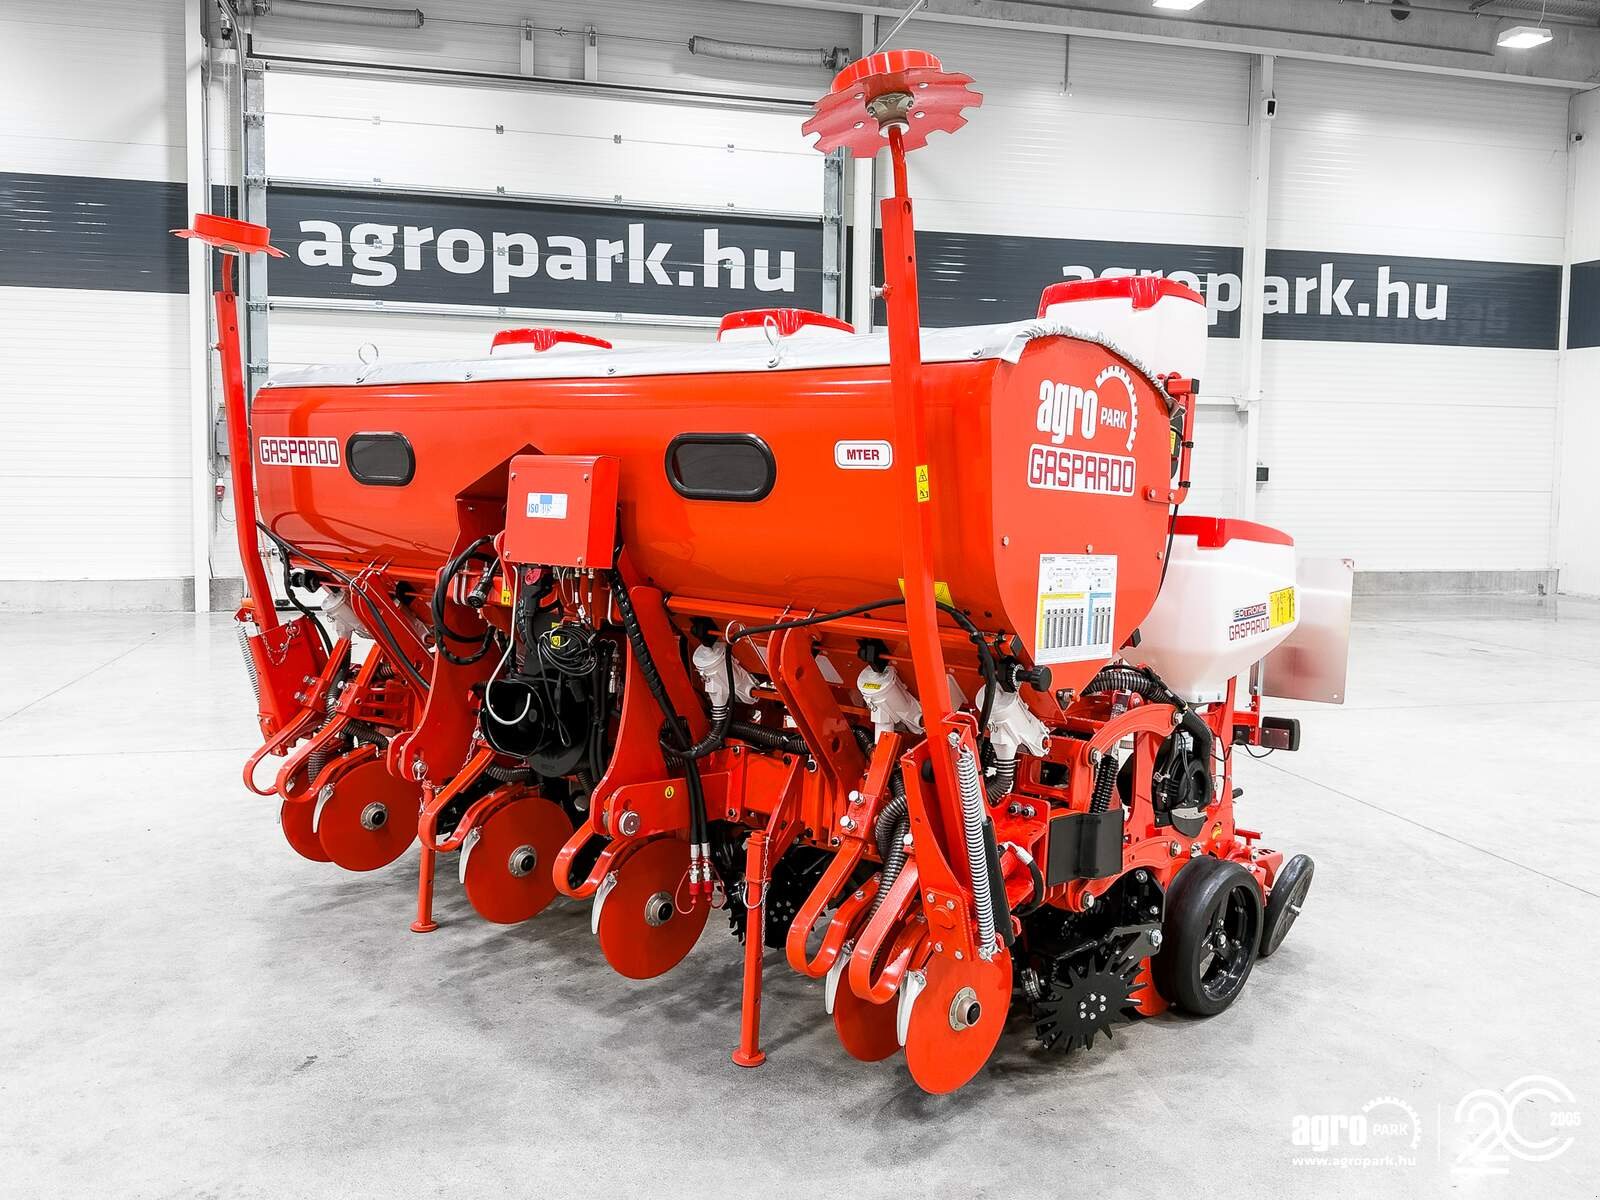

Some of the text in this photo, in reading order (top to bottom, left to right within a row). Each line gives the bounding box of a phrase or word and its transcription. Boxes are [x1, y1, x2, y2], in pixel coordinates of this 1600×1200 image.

[299, 220, 796, 293] agropark.hu
[1062, 263, 1448, 325] park.hu
[1037, 379, 1128, 444] agro PARK
[260, 439, 339, 464] GASPARDO
[846, 449, 880, 460] MTER
[1030, 448, 1134, 493] GASPARDO
[1228, 616, 1270, 641] GASPARDO
